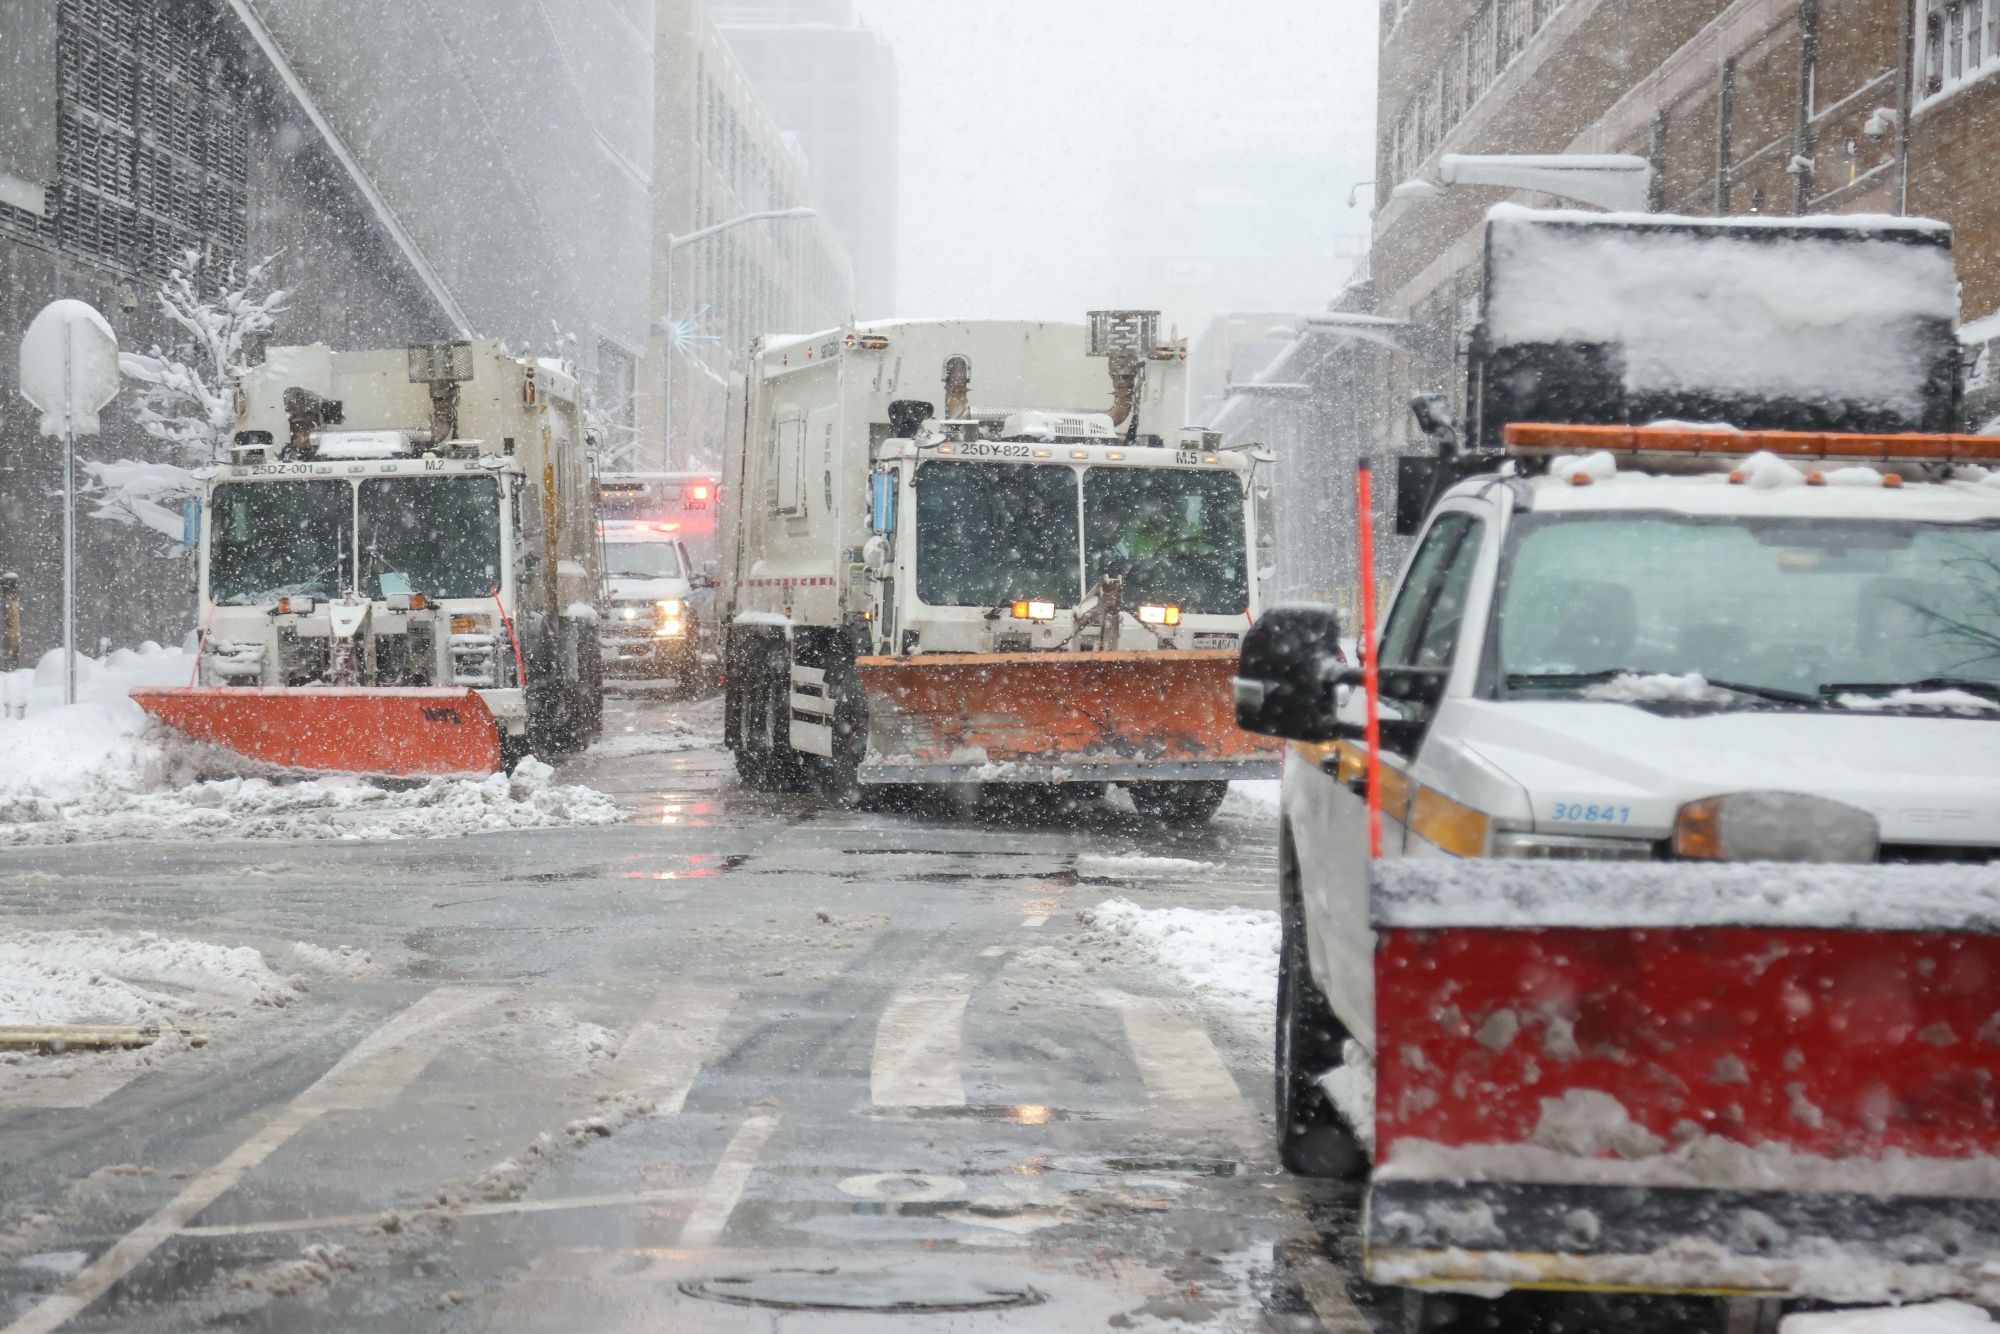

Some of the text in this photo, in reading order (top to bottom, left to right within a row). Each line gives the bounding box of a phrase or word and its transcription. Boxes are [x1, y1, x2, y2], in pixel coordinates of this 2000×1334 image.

[960, 443, 1030, 457] 25DY-822
[425, 459, 445, 471] M.2
[1175, 451, 1198, 465] M.5
[252, 464, 314, 475] 25DZ-001
[1552, 803, 1631, 824] 30841
